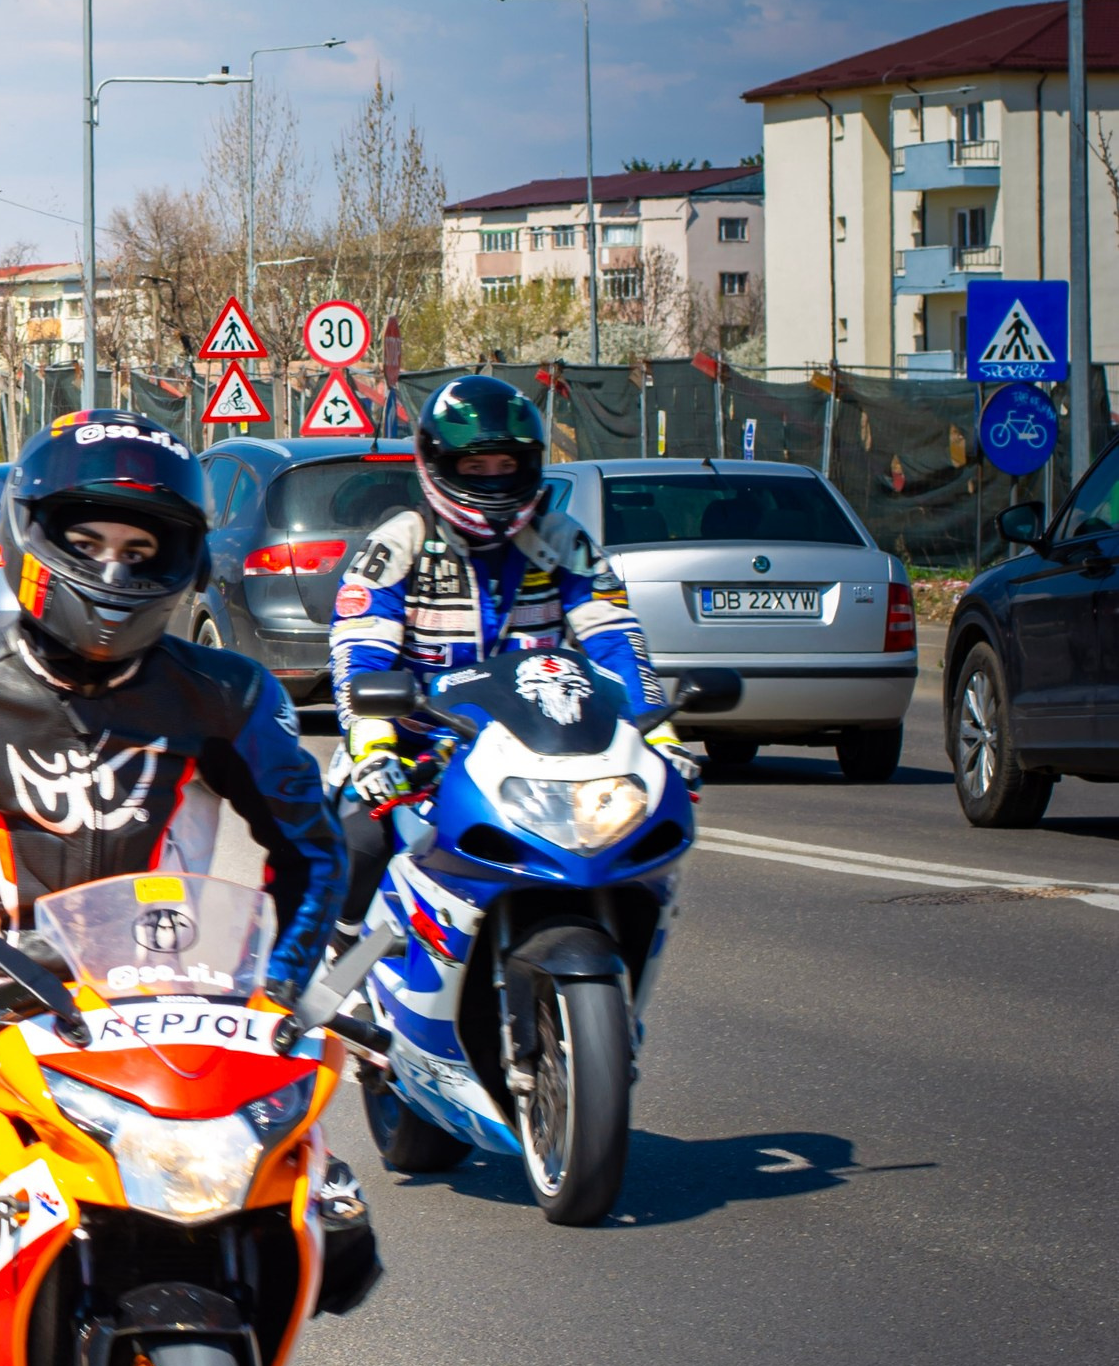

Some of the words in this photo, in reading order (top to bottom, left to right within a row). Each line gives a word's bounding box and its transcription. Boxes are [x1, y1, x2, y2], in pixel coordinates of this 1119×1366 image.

[319, 318, 353, 349] 30
[713, 590, 740, 610] DB
[100, 1013, 258, 1041] REPSOL
